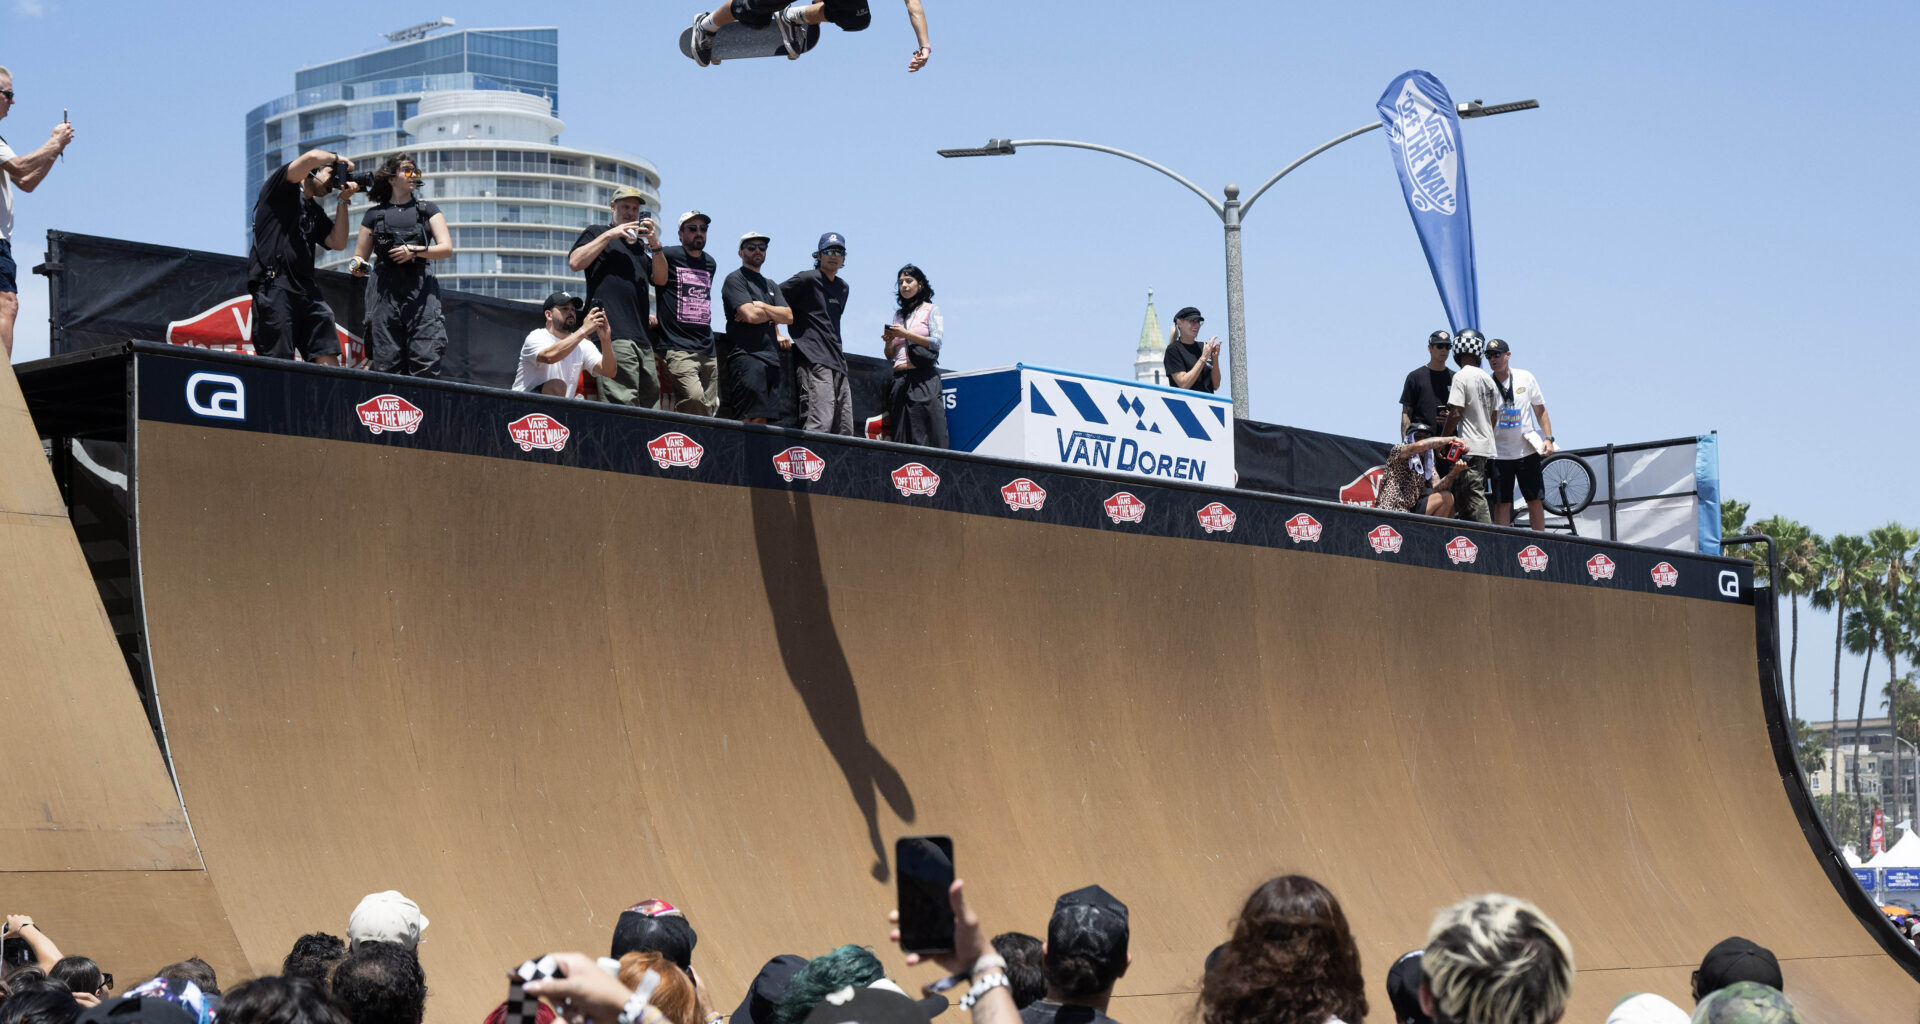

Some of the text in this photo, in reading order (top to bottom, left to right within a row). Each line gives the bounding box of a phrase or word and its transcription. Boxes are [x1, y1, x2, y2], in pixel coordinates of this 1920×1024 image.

[1425, 108, 1454, 160] VANS
[1407, 126, 1433, 168] THE
[376, 399, 400, 411] VANS
[380, 411, 398, 426] THE
[526, 418, 548, 429] VANS
[529, 429, 546, 444] THE
[664, 436, 684, 447] VANS
[666, 447, 682, 461] THE
[788, 450, 806, 461] VANS
[1057, 428, 1206, 481] VAN DOREN
[790, 460, 804, 474] THE
[906, 466, 922, 476] VANS
[908, 476, 920, 490] THE
[1014, 482, 1030, 492] VANS
[1017, 492, 1029, 504] THE
[1116, 496, 1130, 504] VANS
[1118, 504, 1129, 516] THE
